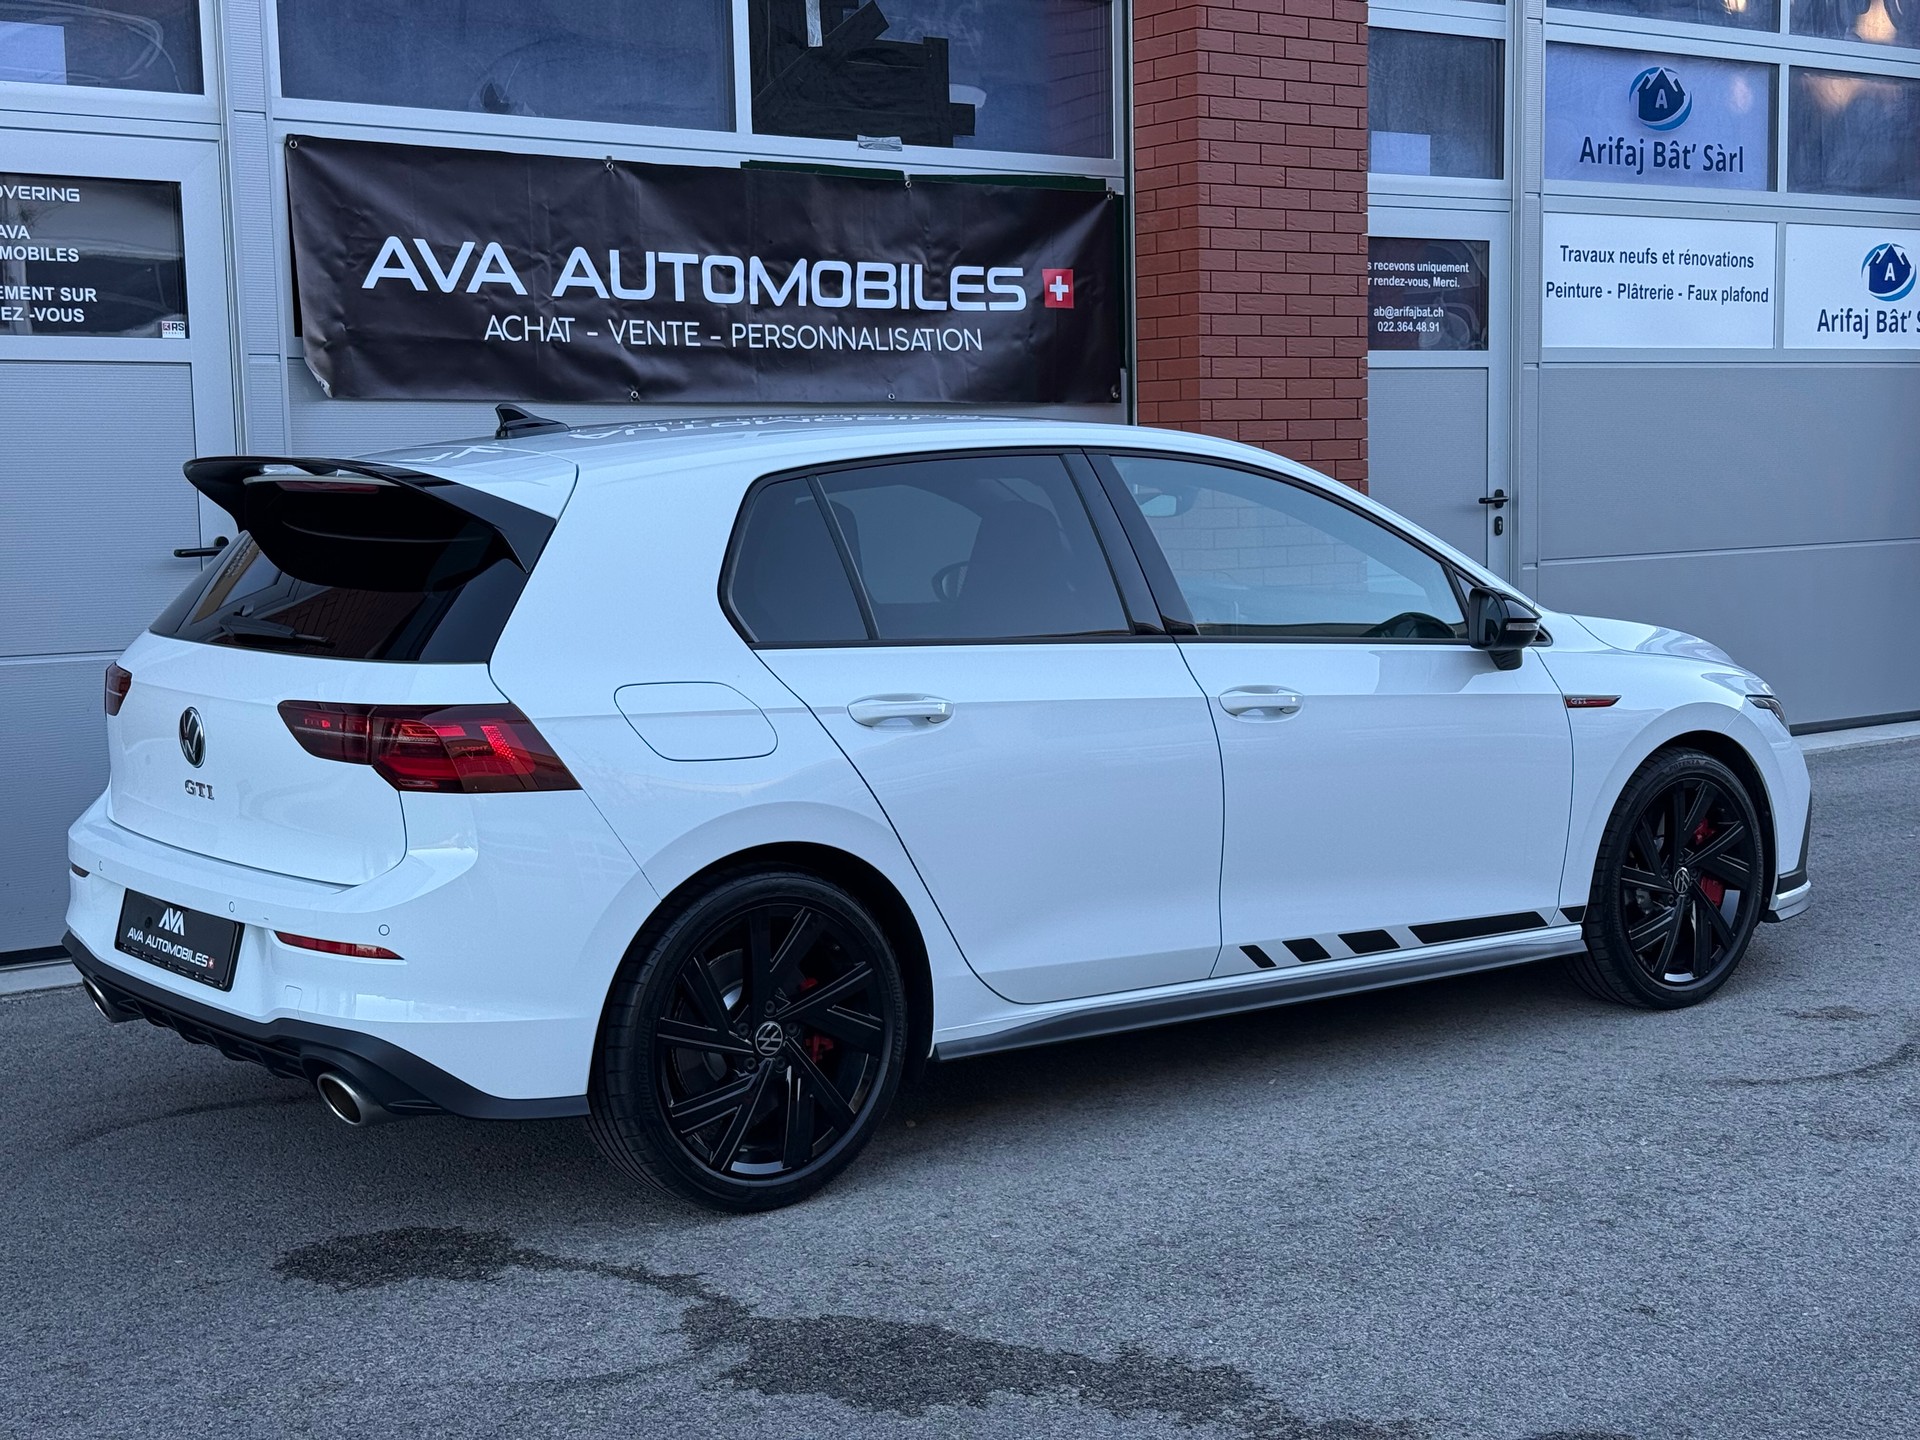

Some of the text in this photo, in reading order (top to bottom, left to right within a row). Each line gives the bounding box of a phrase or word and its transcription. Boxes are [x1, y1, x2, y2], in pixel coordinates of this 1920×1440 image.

[1579, 136, 1645, 175] Arifaj
[1702, 143, 1744, 173] Sàrl
[0, 224, 31, 240] AVA
[1373, 261, 1416, 272] recevons
[1416, 261, 1470, 275] uniquement
[1559, 244, 1755, 269] Travaux neufs et rénovations
[361, 235, 1027, 312] AVA AUTOMOBILES
[1373, 275, 1431, 289] rendez-vous,
[1432, 276, 1460, 288] Merci.
[60, 287, 98, 302] SUR
[1546, 281, 1603, 299] Peinture
[1617, 282, 1674, 301] Plâtrerie
[1687, 284, 1718, 302] Faux
[1721, 286, 1769, 306] plafond
[1373, 305, 1444, 320] ab@arifajbat.ch
[1816, 307, 1869, 340] Arifaj
[484, 314, 576, 344] ACHAT
[607, 318, 702, 348] VENTE
[731, 323, 983, 353] PERSONNALISATION
[1377, 321, 1440, 333] 022.364.48.91
[184, 779, 215, 801] GTI
[158, 908, 185, 936] AVA
[127, 927, 210, 968] AVA AUTOMOBILES
